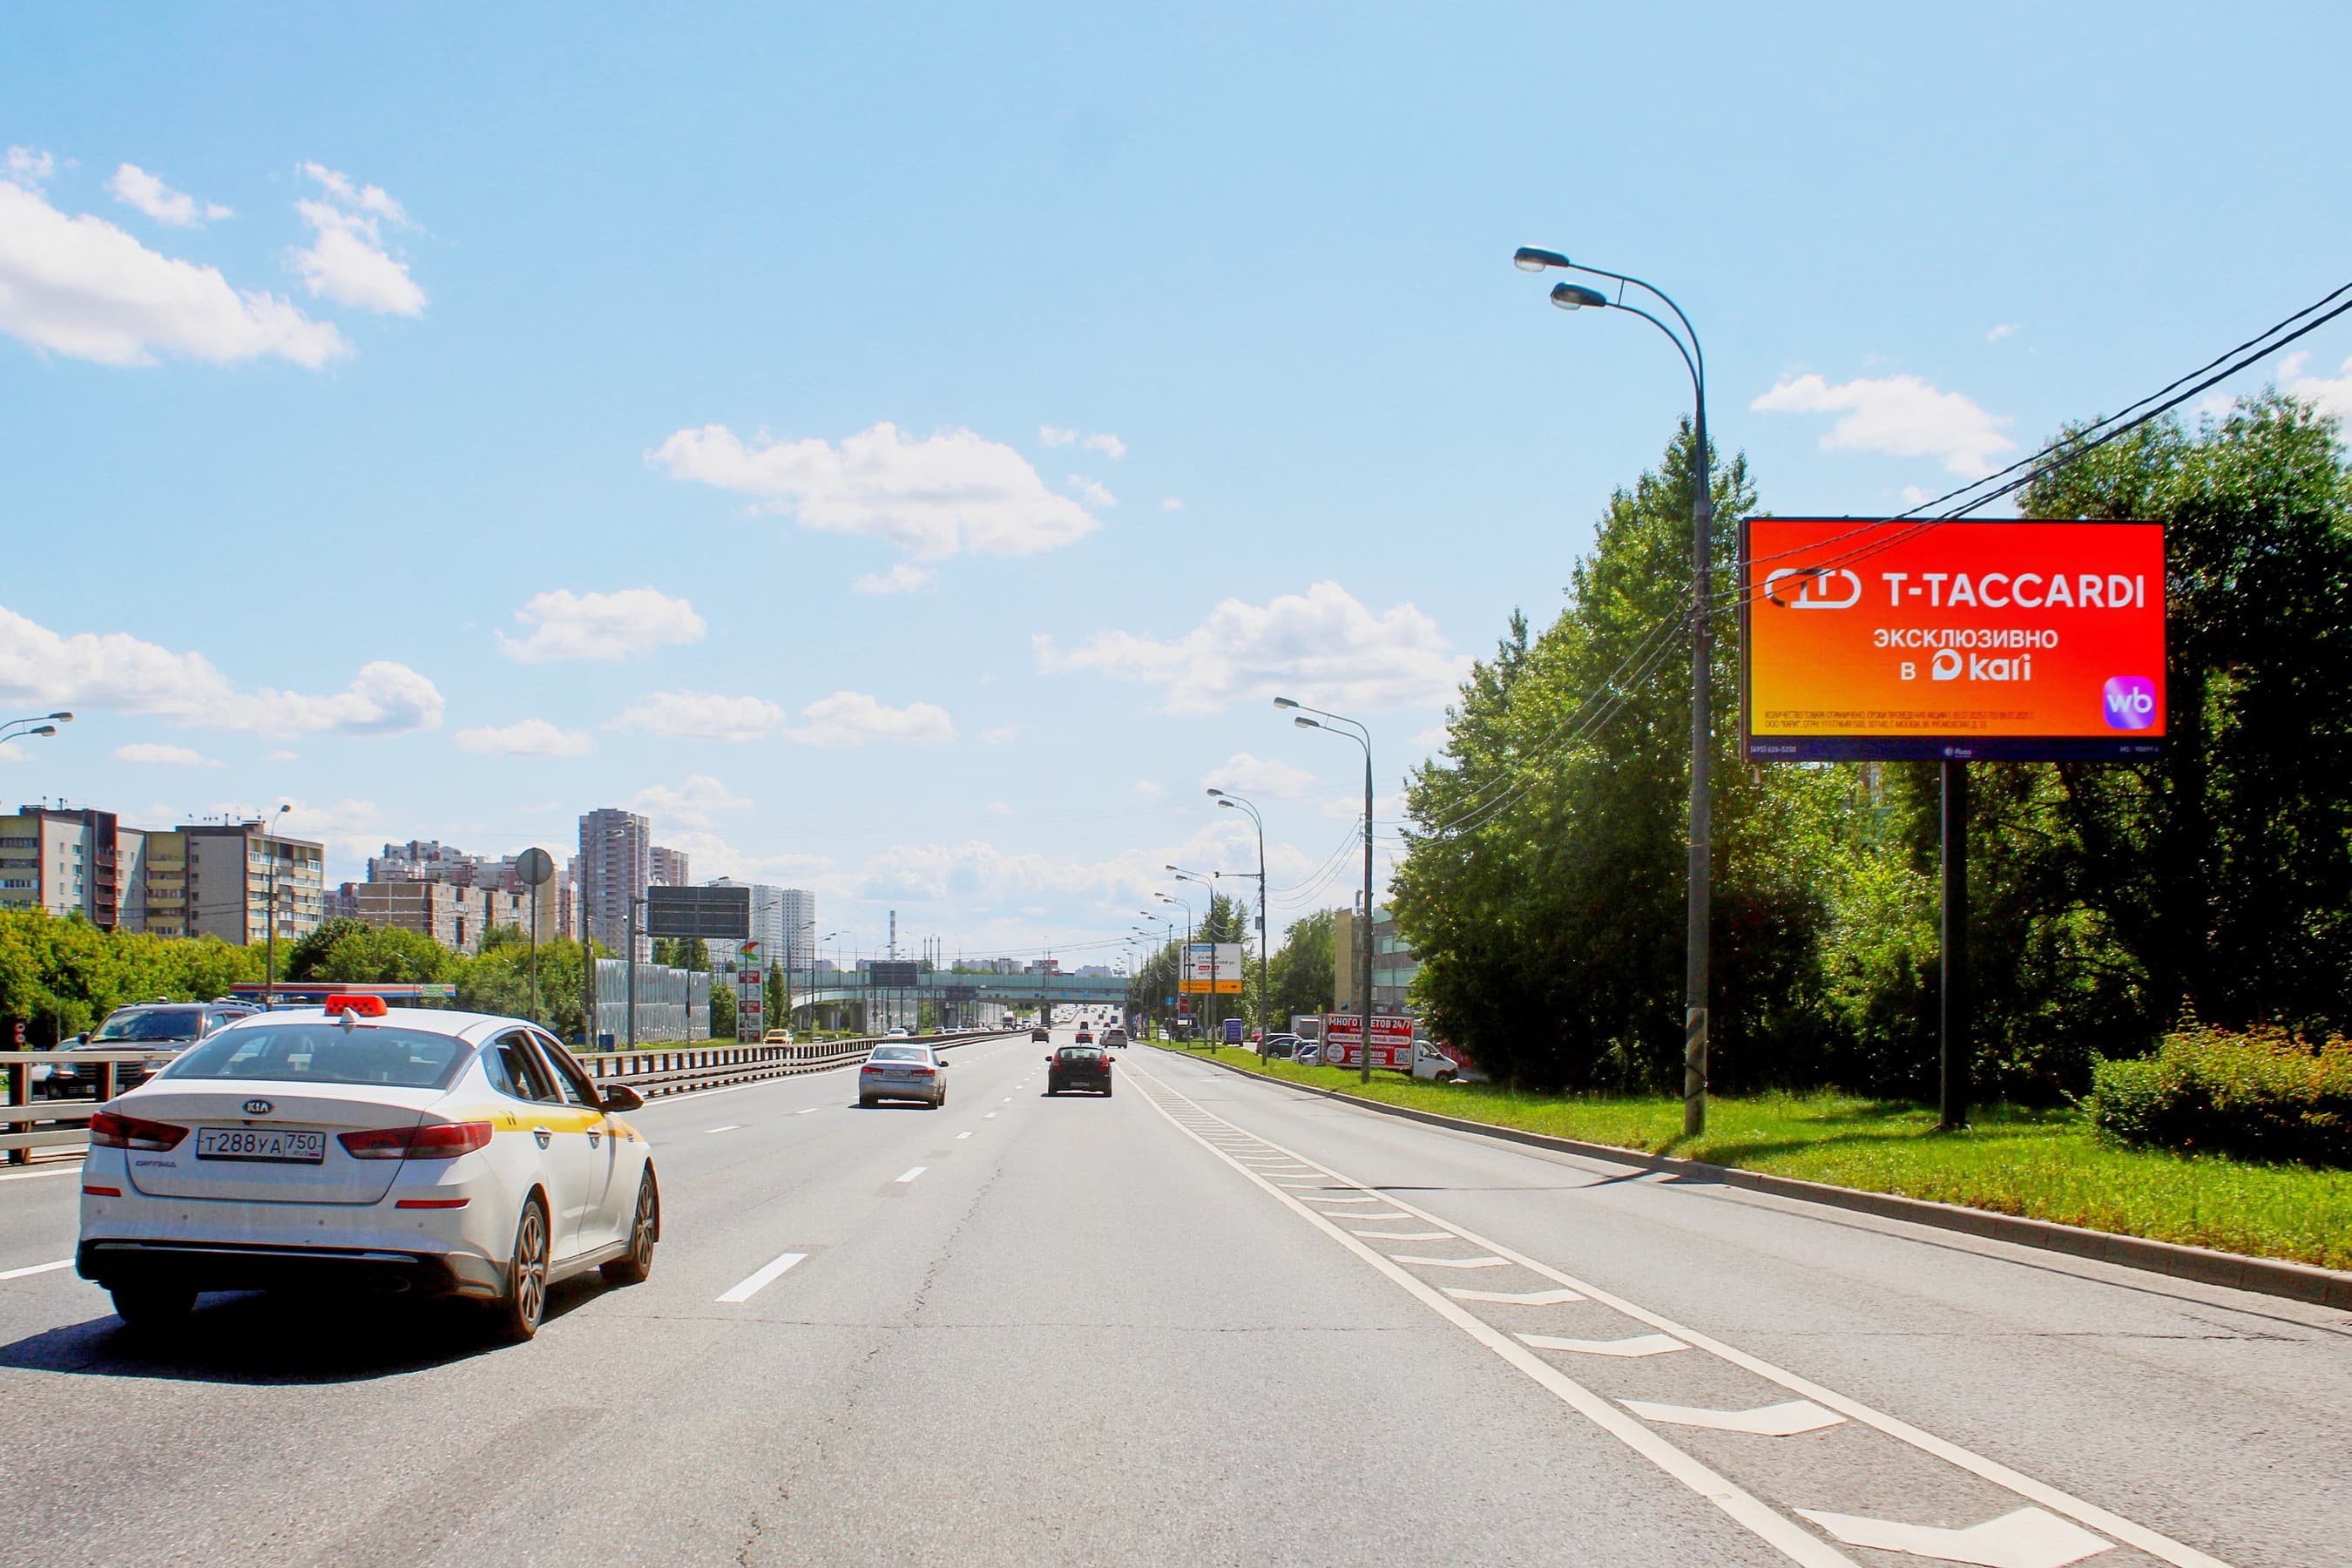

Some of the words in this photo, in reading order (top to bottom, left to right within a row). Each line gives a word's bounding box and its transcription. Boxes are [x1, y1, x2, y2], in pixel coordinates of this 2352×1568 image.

[1882, 572, 2145, 608] T-TACCARDI
[1874, 629, 2058, 648] ЭКСКЛЮЗИВНО
[1970, 653, 2031, 681] kari
[2107, 686, 2153, 713] wb
[1328, 1017, 1357, 1026] МНОГО
[1359, 1019, 1391, 1028] ЕТОВ
[1392, 1020, 1410, 1030] 24/7
[247, 1101, 269, 1112] KIA
[287, 1134, 317, 1150] 750
